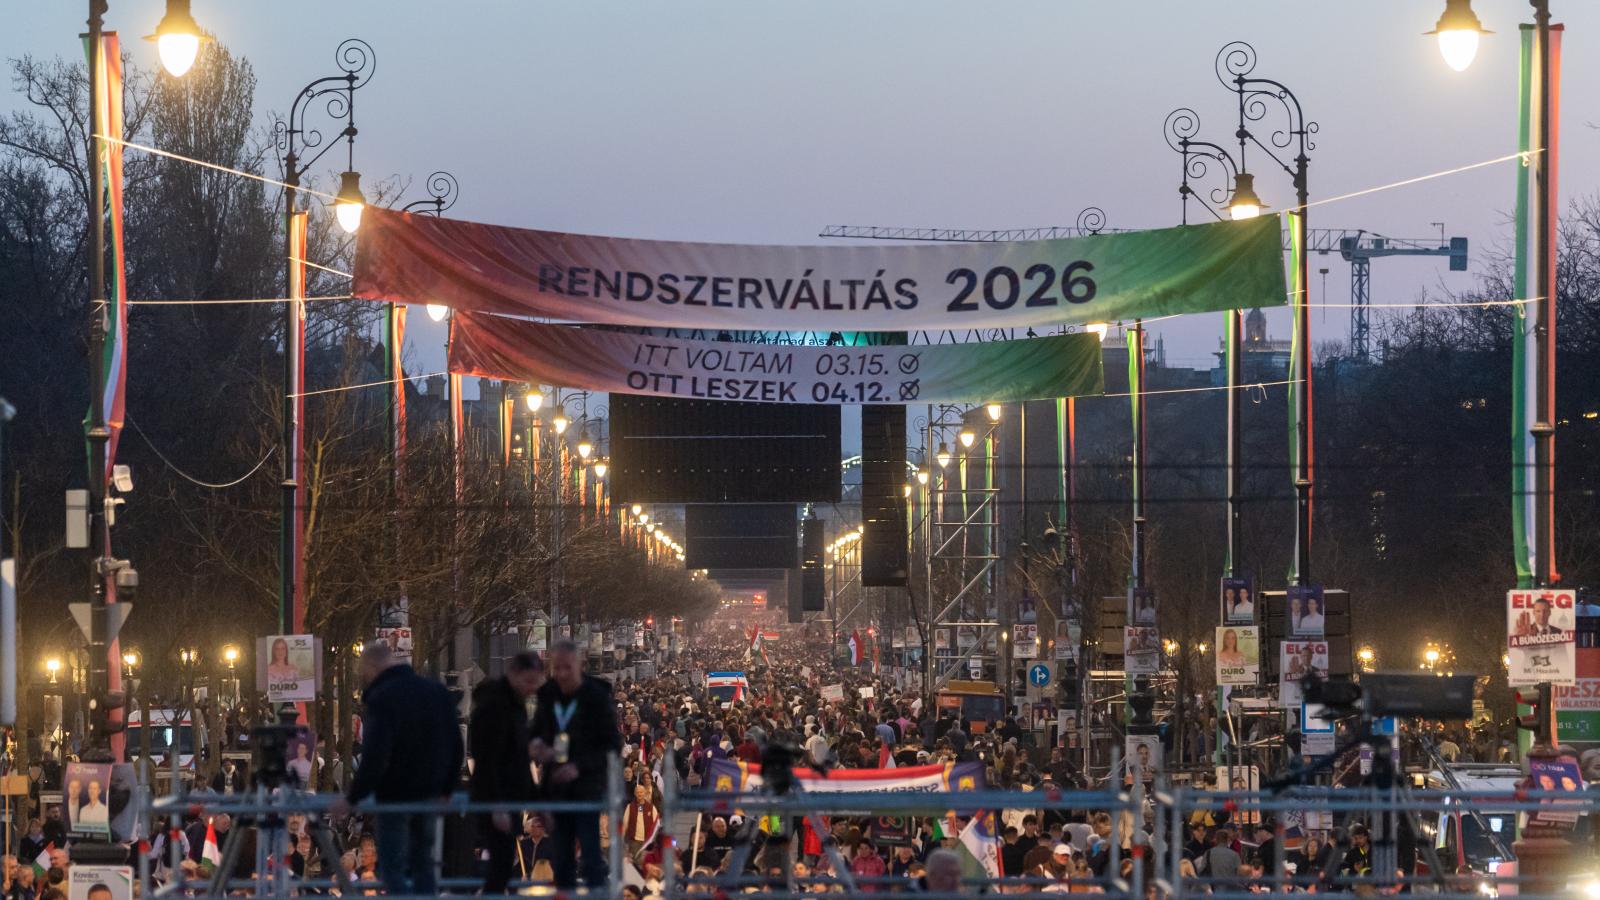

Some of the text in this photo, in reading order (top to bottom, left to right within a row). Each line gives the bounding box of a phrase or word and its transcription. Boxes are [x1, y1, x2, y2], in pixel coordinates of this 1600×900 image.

[538, 260, 1097, 312] RENDSZERVÁLTÁS 2026
[633, 343, 890, 376] ITT VOLTAM 03.15.
[627, 370, 891, 403] OTT LESZEK 04.12.
[1512, 590, 1573, 610] ELÉG
[1511, 636, 1519, 646] A
